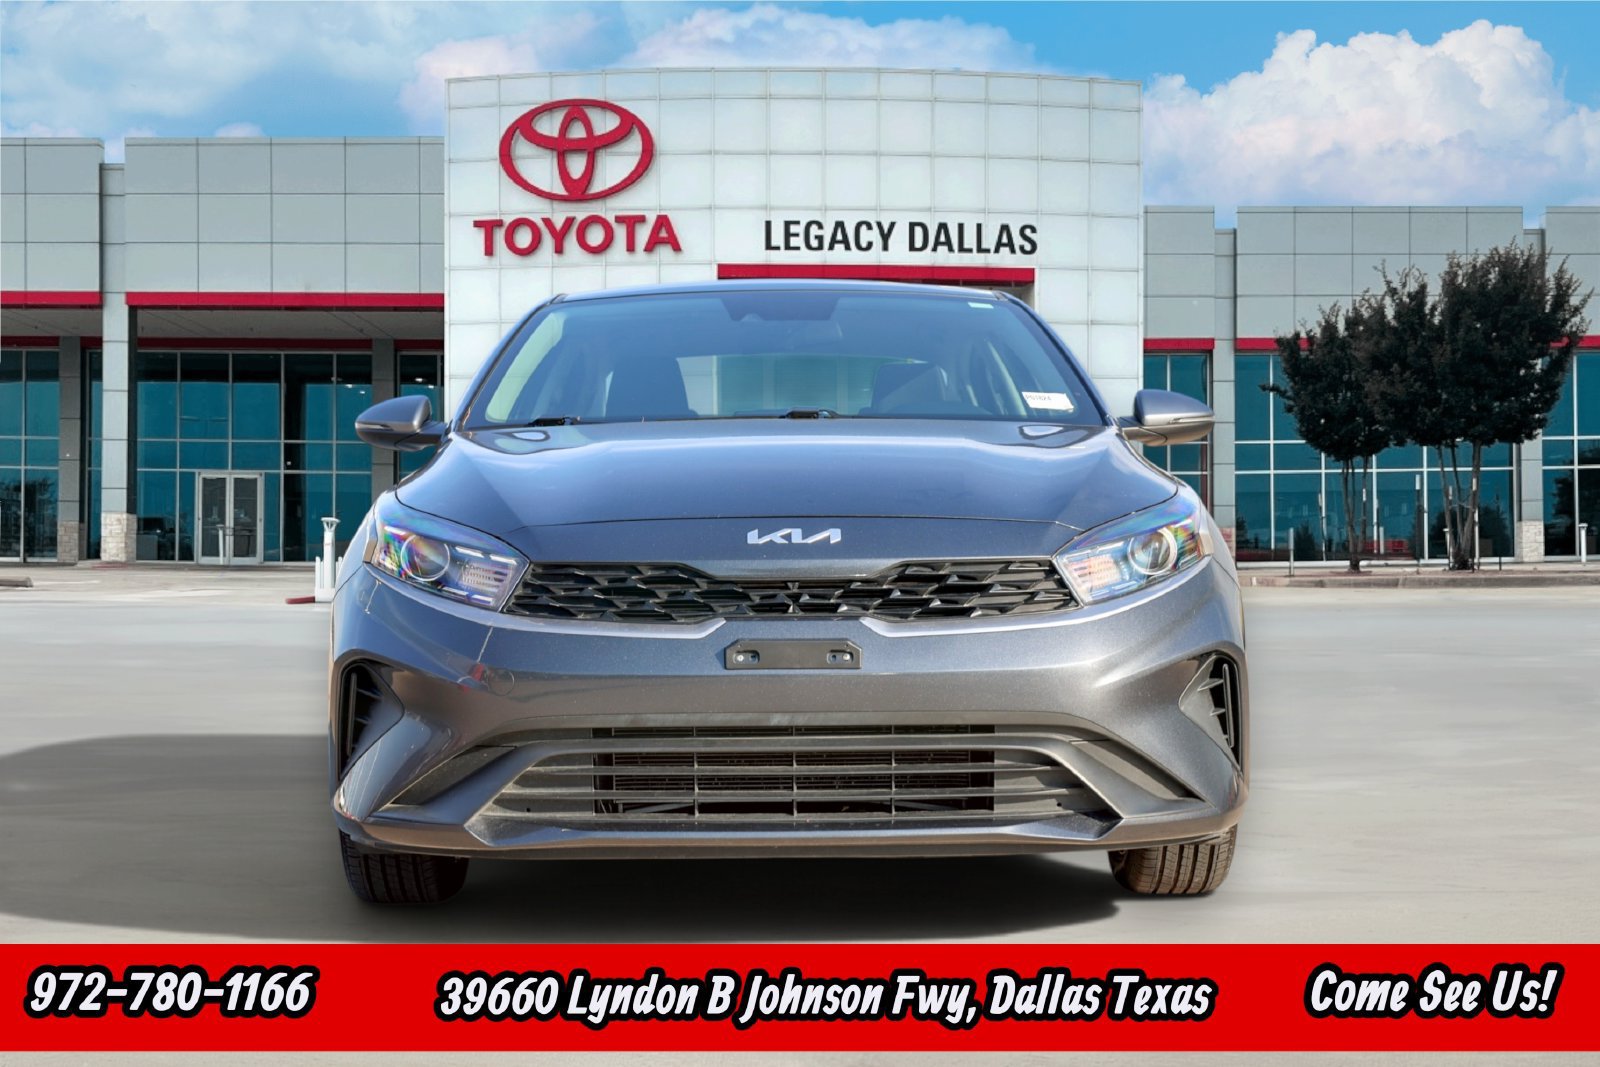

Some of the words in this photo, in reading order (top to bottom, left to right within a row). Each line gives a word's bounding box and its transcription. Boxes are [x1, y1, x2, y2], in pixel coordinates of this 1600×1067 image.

[473, 214, 682, 257] TOYOTA
[764, 219, 897, 253] LEGACY
[908, 221, 1038, 256] DALLAS
[746, 527, 842, 545] KIA
